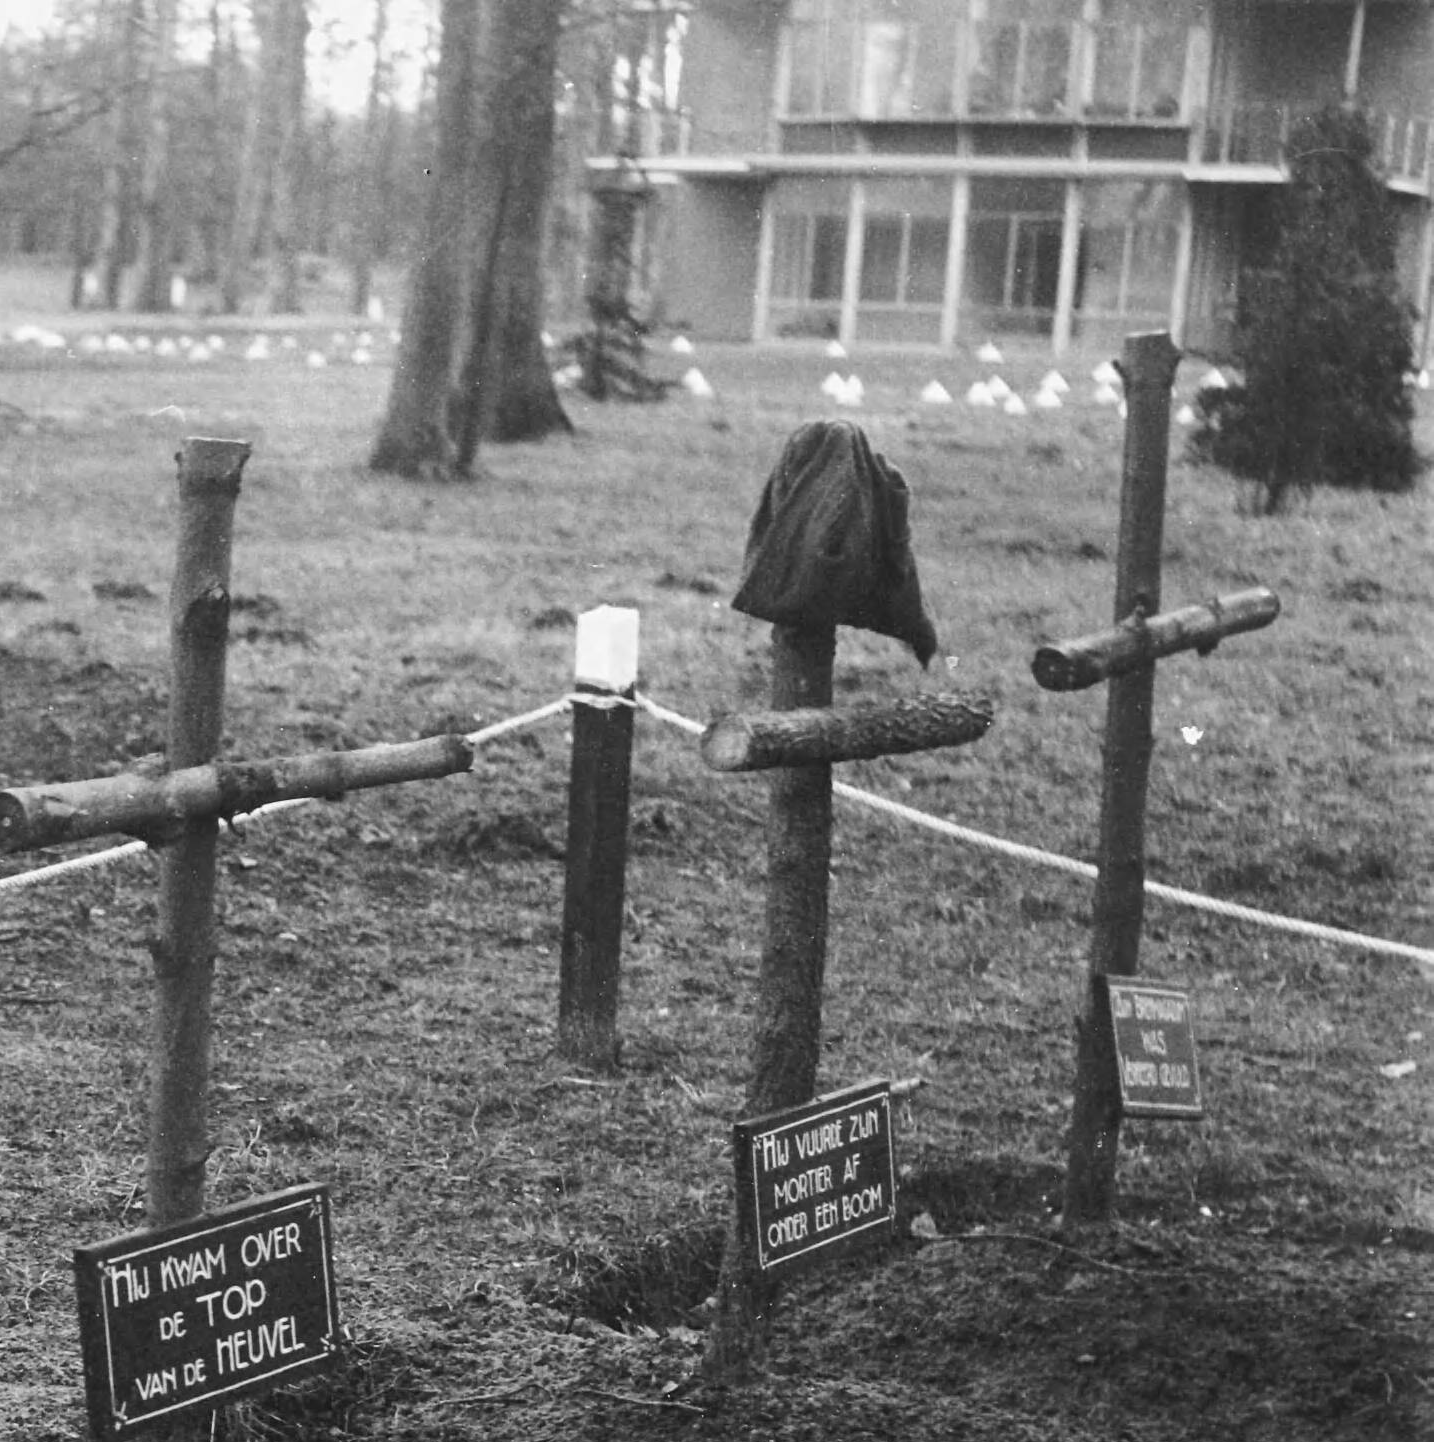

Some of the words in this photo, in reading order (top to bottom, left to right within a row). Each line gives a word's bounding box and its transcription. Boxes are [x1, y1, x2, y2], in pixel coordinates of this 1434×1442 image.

[762, 1133, 790, 1172] HIJ
[774, 1165, 834, 1210] MORTIER
[843, 1153, 861, 1184] AF
[768, 1211, 809, 1248] ONDER
[815, 1199, 839, 1233] EEN
[842, 1183, 883, 1222] BOOM
[110, 1262, 150, 1308] HIJ
[160, 1243, 226, 1293] KWAM
[240, 1222, 302, 1268] OVER
[159, 1311, 187, 1341] DE
[195, 1278, 266, 1327] TOP
[135, 1367, 178, 1401] VAN
[183, 1358, 207, 1387] DE
[216, 1315, 306, 1375] HEUVEL
